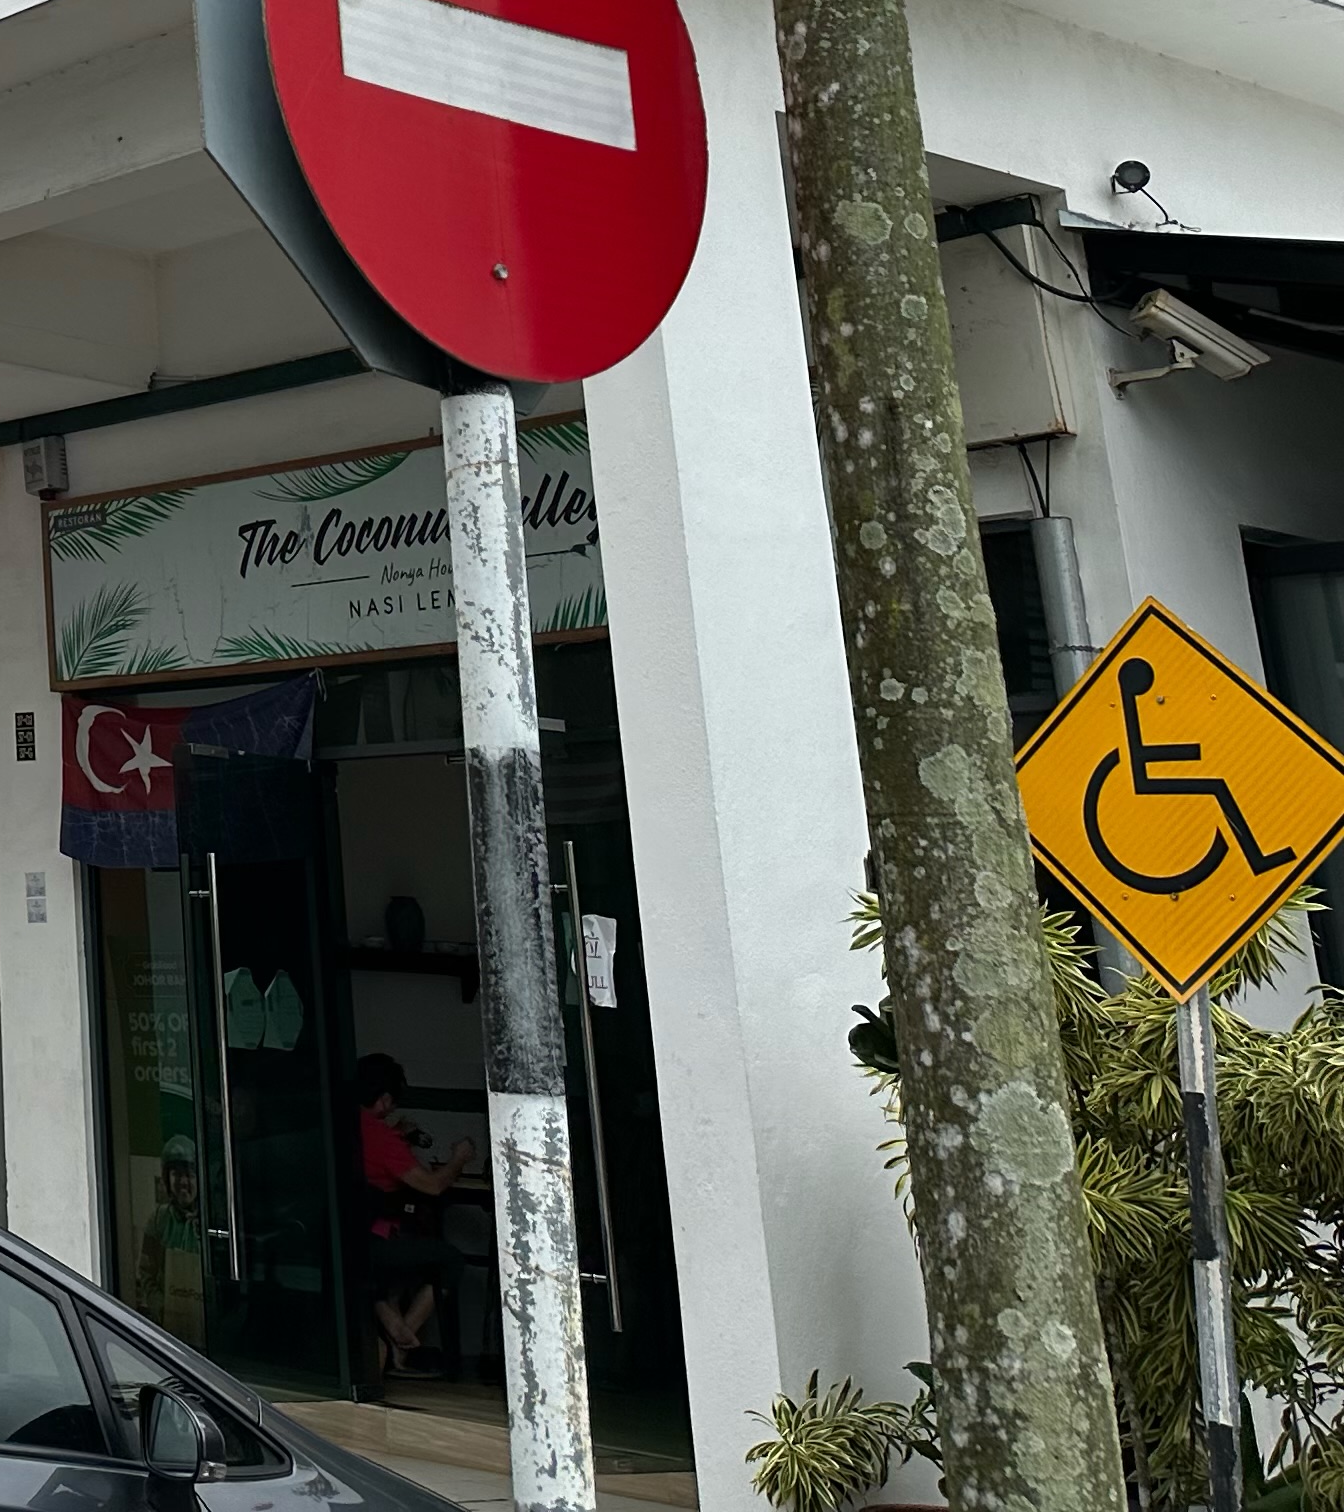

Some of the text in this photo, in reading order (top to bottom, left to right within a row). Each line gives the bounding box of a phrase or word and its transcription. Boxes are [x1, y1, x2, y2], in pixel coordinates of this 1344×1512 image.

[57, 513, 102, 529] RESTORAN
[238, 519, 305, 579] The
[313, 507, 451, 566] Coconu
[381, 557, 453, 586] Nonya Hou
[349, 595, 403, 619] NASI
[128, 1012, 166, 1032] 50%
[131, 1036, 178, 1057] first 2
